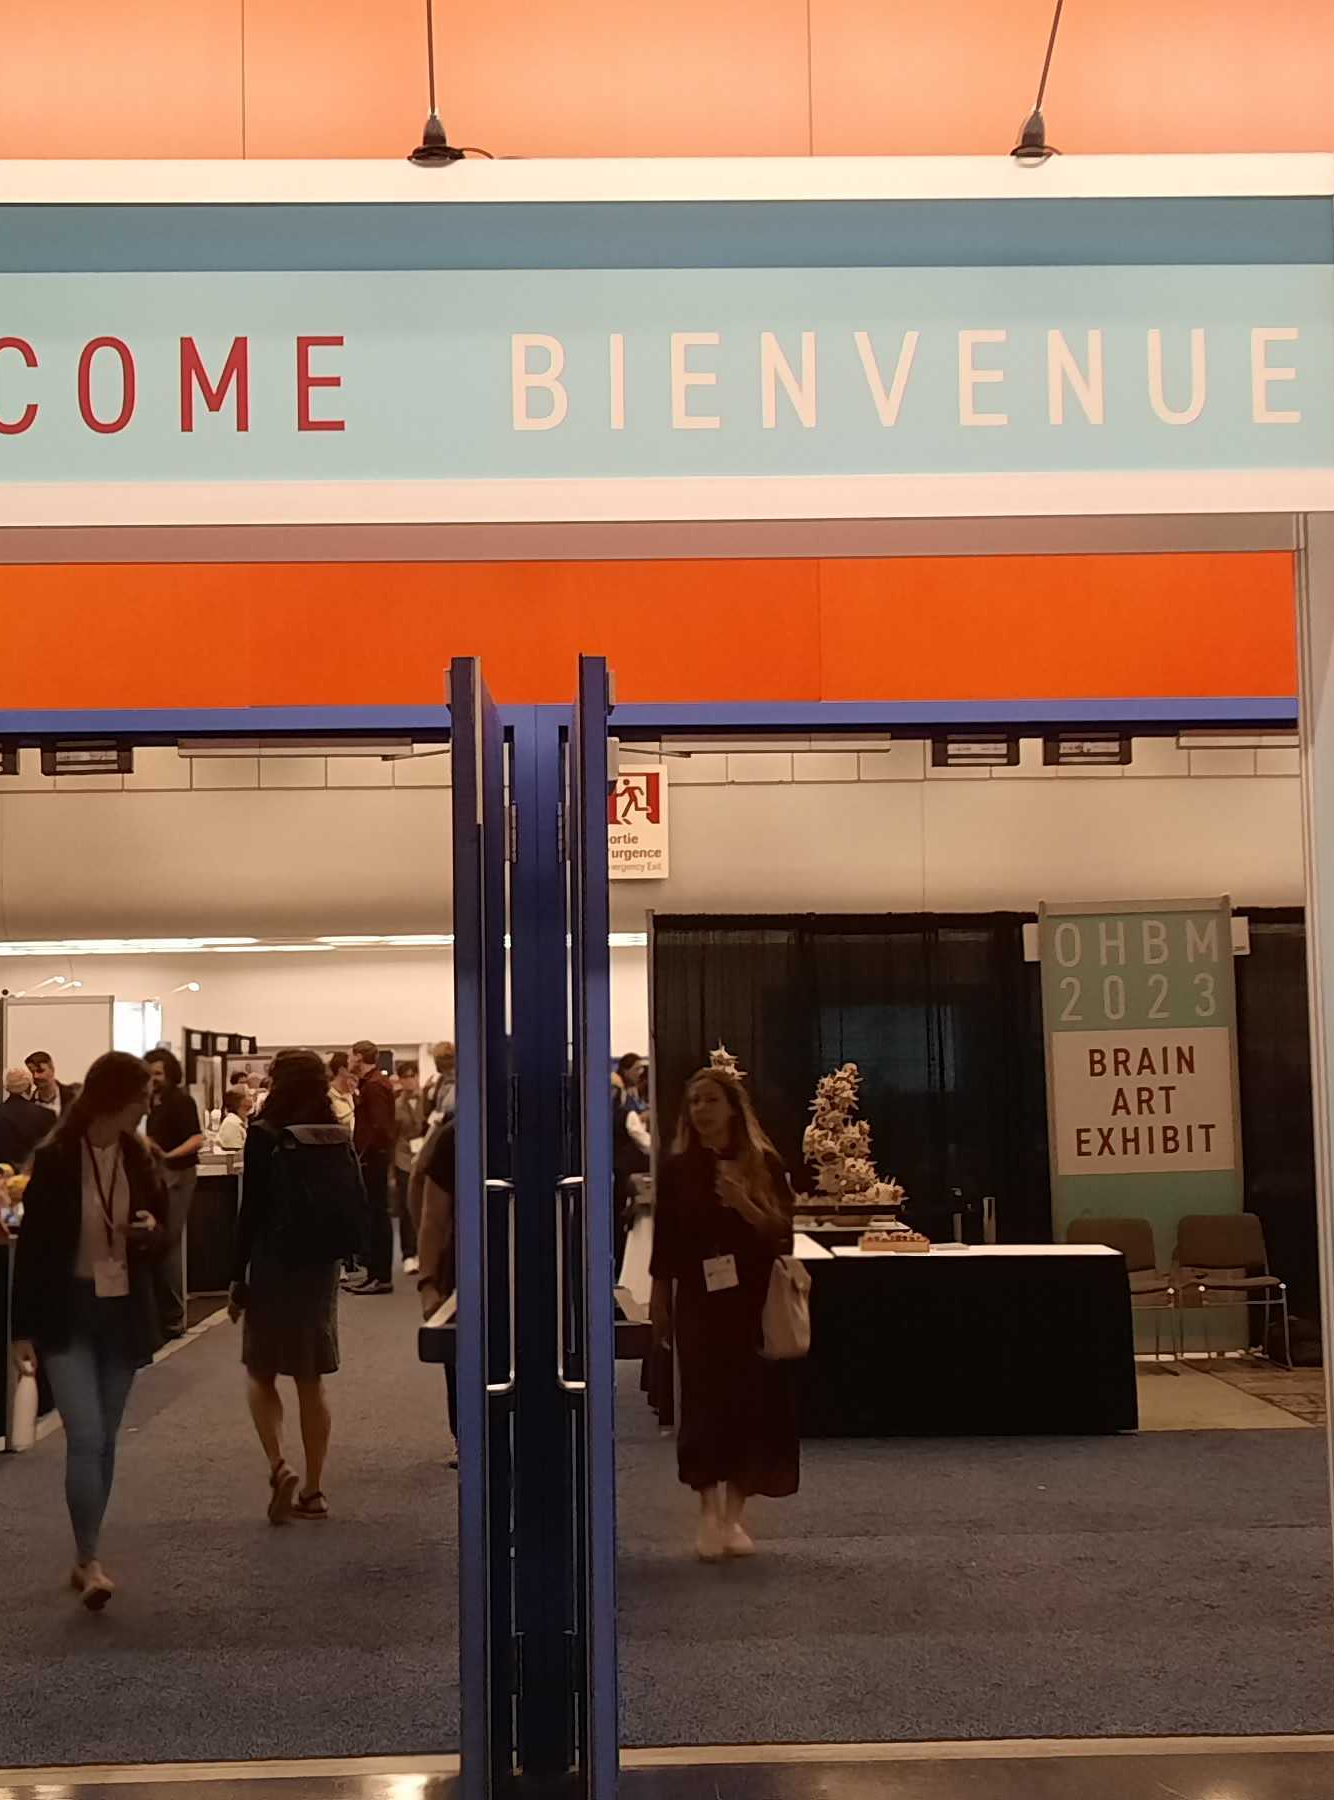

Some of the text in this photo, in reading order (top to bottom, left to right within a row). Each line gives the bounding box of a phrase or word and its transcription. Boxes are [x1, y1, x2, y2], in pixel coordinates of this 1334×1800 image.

[511, 327, 1301, 431] BIENVENUE
[609, 832, 639, 845] ortie
[611, 849, 662, 861] urgence
[1054, 919, 1218, 967] OHBM
[1059, 972, 1216, 1021] 2023
[1089, 1045, 1194, 1077] BRAIN
[1111, 1086, 1176, 1116] ART
[1076, 1124, 1215, 1156] EXHIBIT
